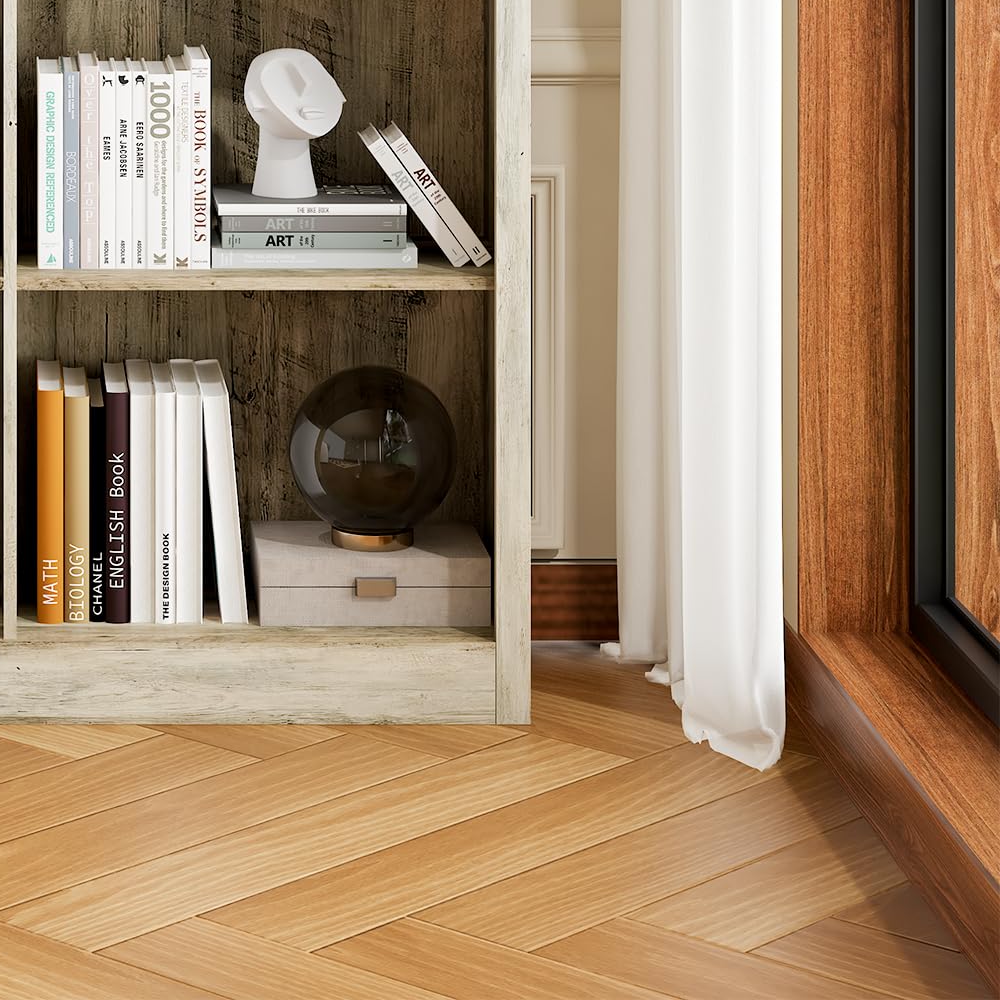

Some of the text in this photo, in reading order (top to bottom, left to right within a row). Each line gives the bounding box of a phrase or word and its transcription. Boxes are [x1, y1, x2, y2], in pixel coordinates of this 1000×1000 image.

[46, 91, 55, 132] GRAPHIC
[150, 82, 170, 138] 1000
[195, 111, 206, 151] BOOK
[46, 136, 55, 169] DESIGN
[66, 151, 77, 202] BORDEAUX
[414, 168, 436, 190] ART
[46, 173, 55, 233] REFERENCED
[195, 169, 206, 241] SYMBOLS
[265, 218, 294, 229] ART
[266, 235, 294, 246] ART
[109, 453, 124, 588] ENGLISH Book
[43, 560, 58, 604] MATH
[69, 544, 86, 620] BIOLOGY
[93, 552, 102, 615] CHANEL
